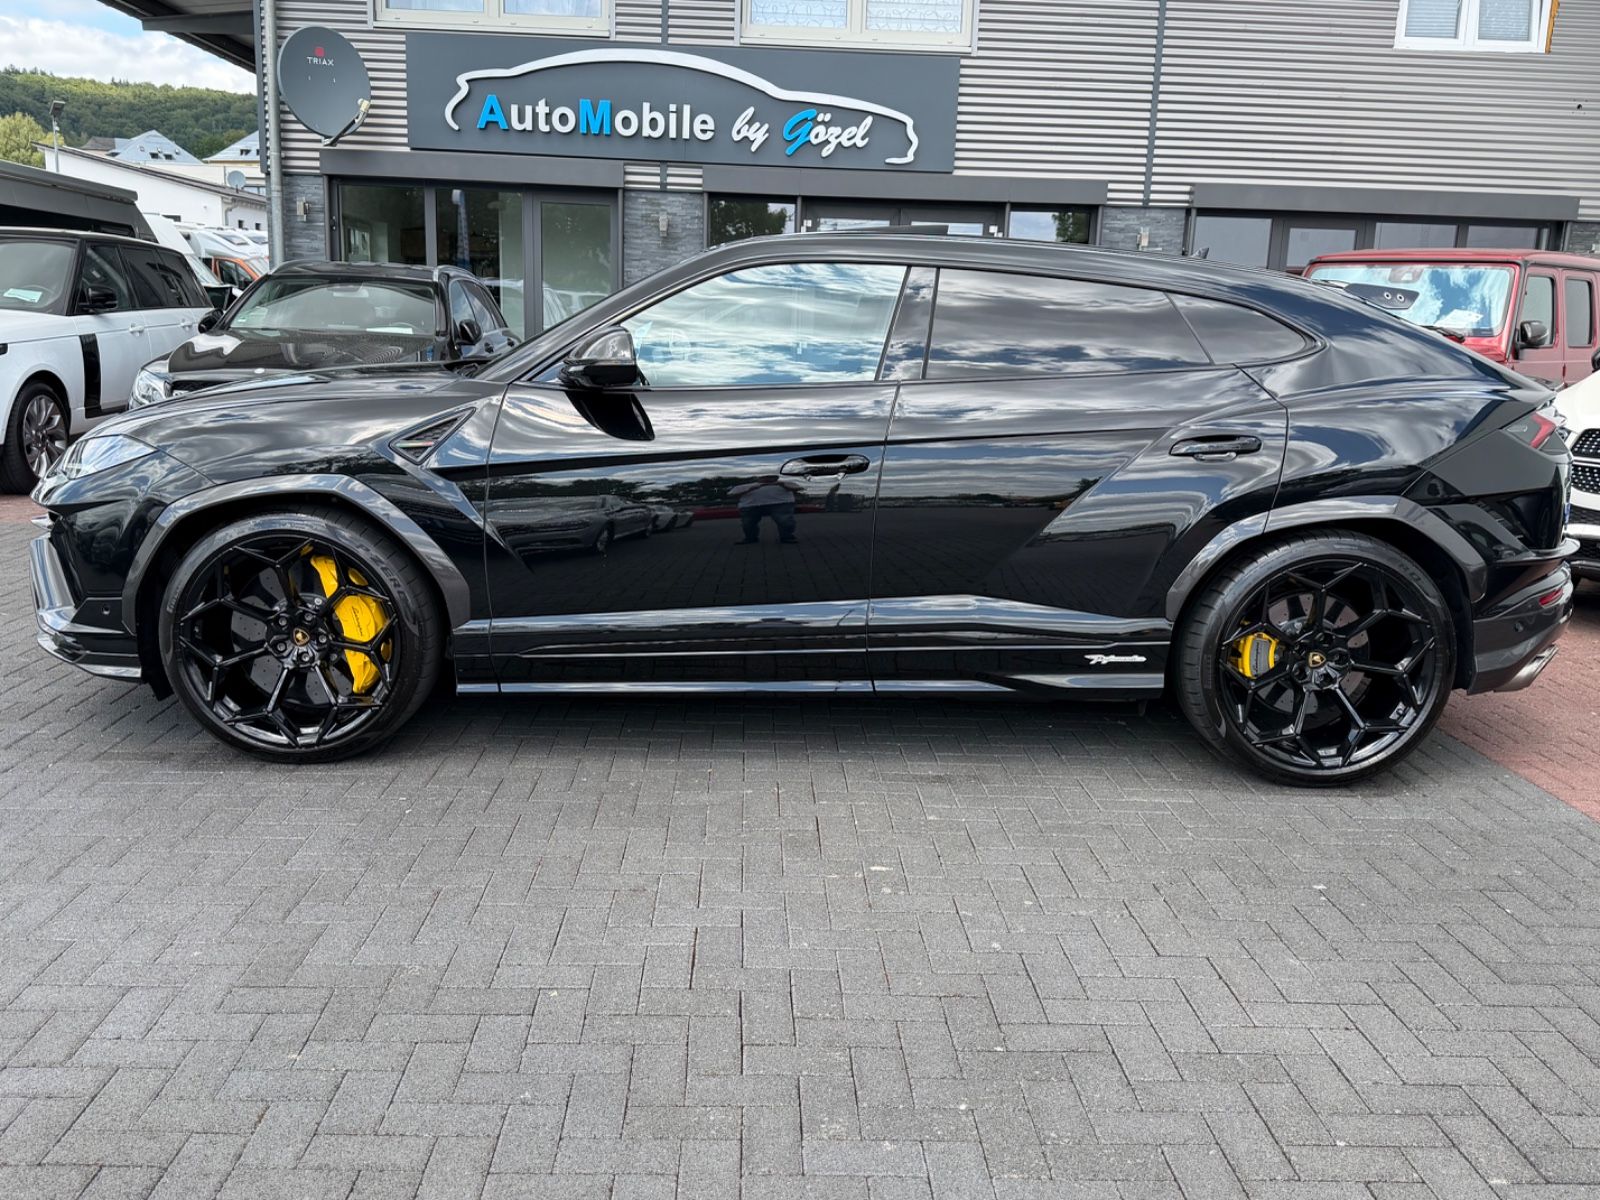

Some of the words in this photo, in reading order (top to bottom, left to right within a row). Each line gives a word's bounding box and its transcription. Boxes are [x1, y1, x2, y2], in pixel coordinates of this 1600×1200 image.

[306, 56, 335, 67] TRIAX
[477, 94, 715, 141] AutoMobile
[731, 106, 769, 152] by
[783, 108, 873, 157] Gözel
